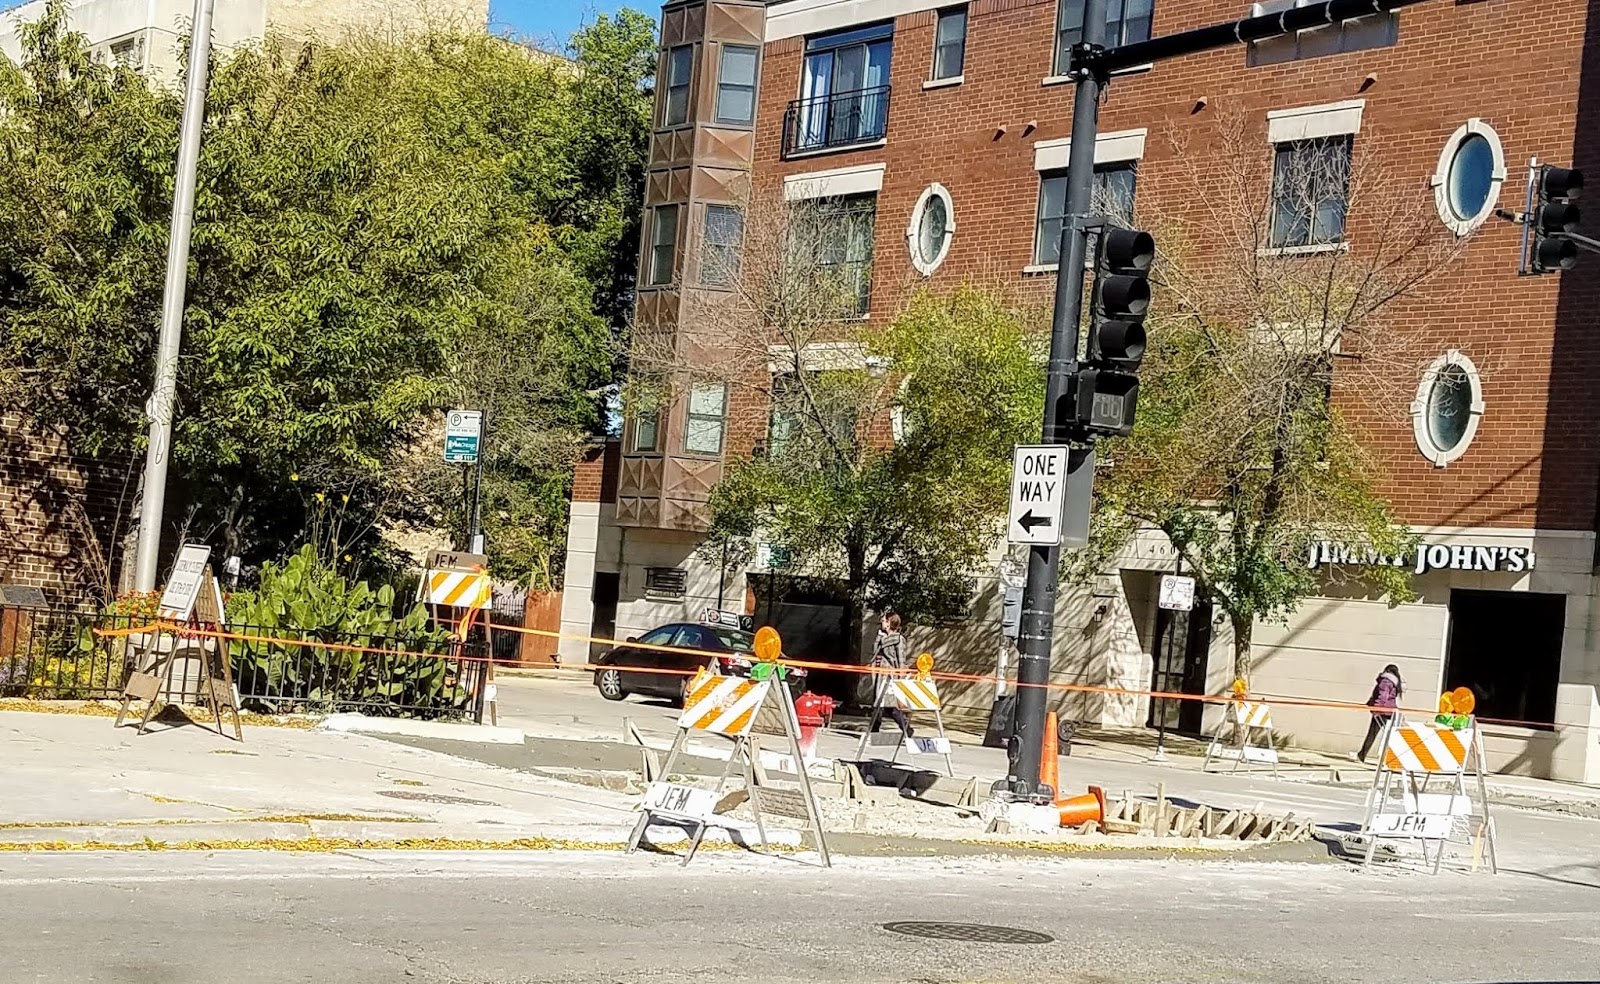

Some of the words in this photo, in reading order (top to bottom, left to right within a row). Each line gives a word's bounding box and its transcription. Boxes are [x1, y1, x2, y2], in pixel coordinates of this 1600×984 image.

[1023, 455, 1057, 475] ONE
[1020, 481, 1056, 502] WAY
[430, 553, 457, 569] JEM
[1414, 544, 1524, 575] JOHN'S
[653, 786, 691, 811] JEM
[1387, 816, 1426, 833] JEM
